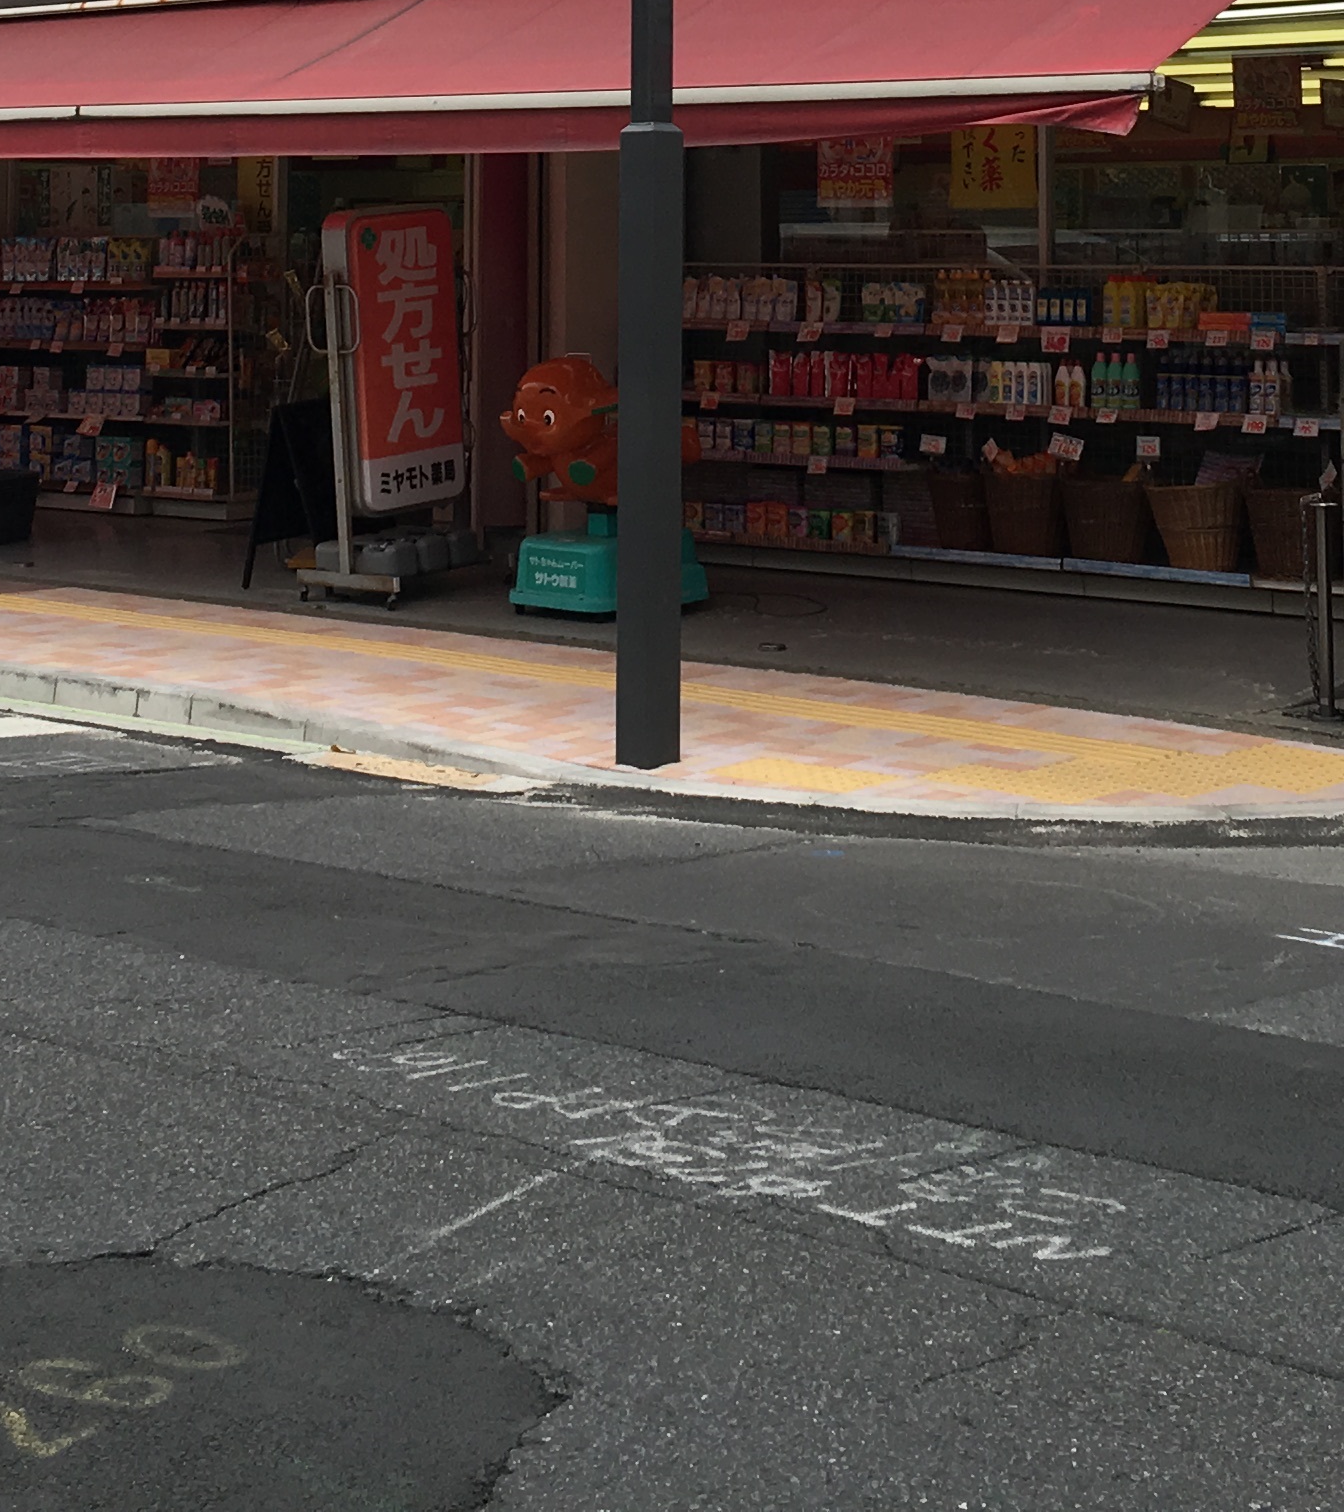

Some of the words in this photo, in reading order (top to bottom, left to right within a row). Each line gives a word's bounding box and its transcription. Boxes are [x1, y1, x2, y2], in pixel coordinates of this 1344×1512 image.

[375, 225, 445, 443] 処方せん
[380, 458, 455, 495] ミヤモト薬局
